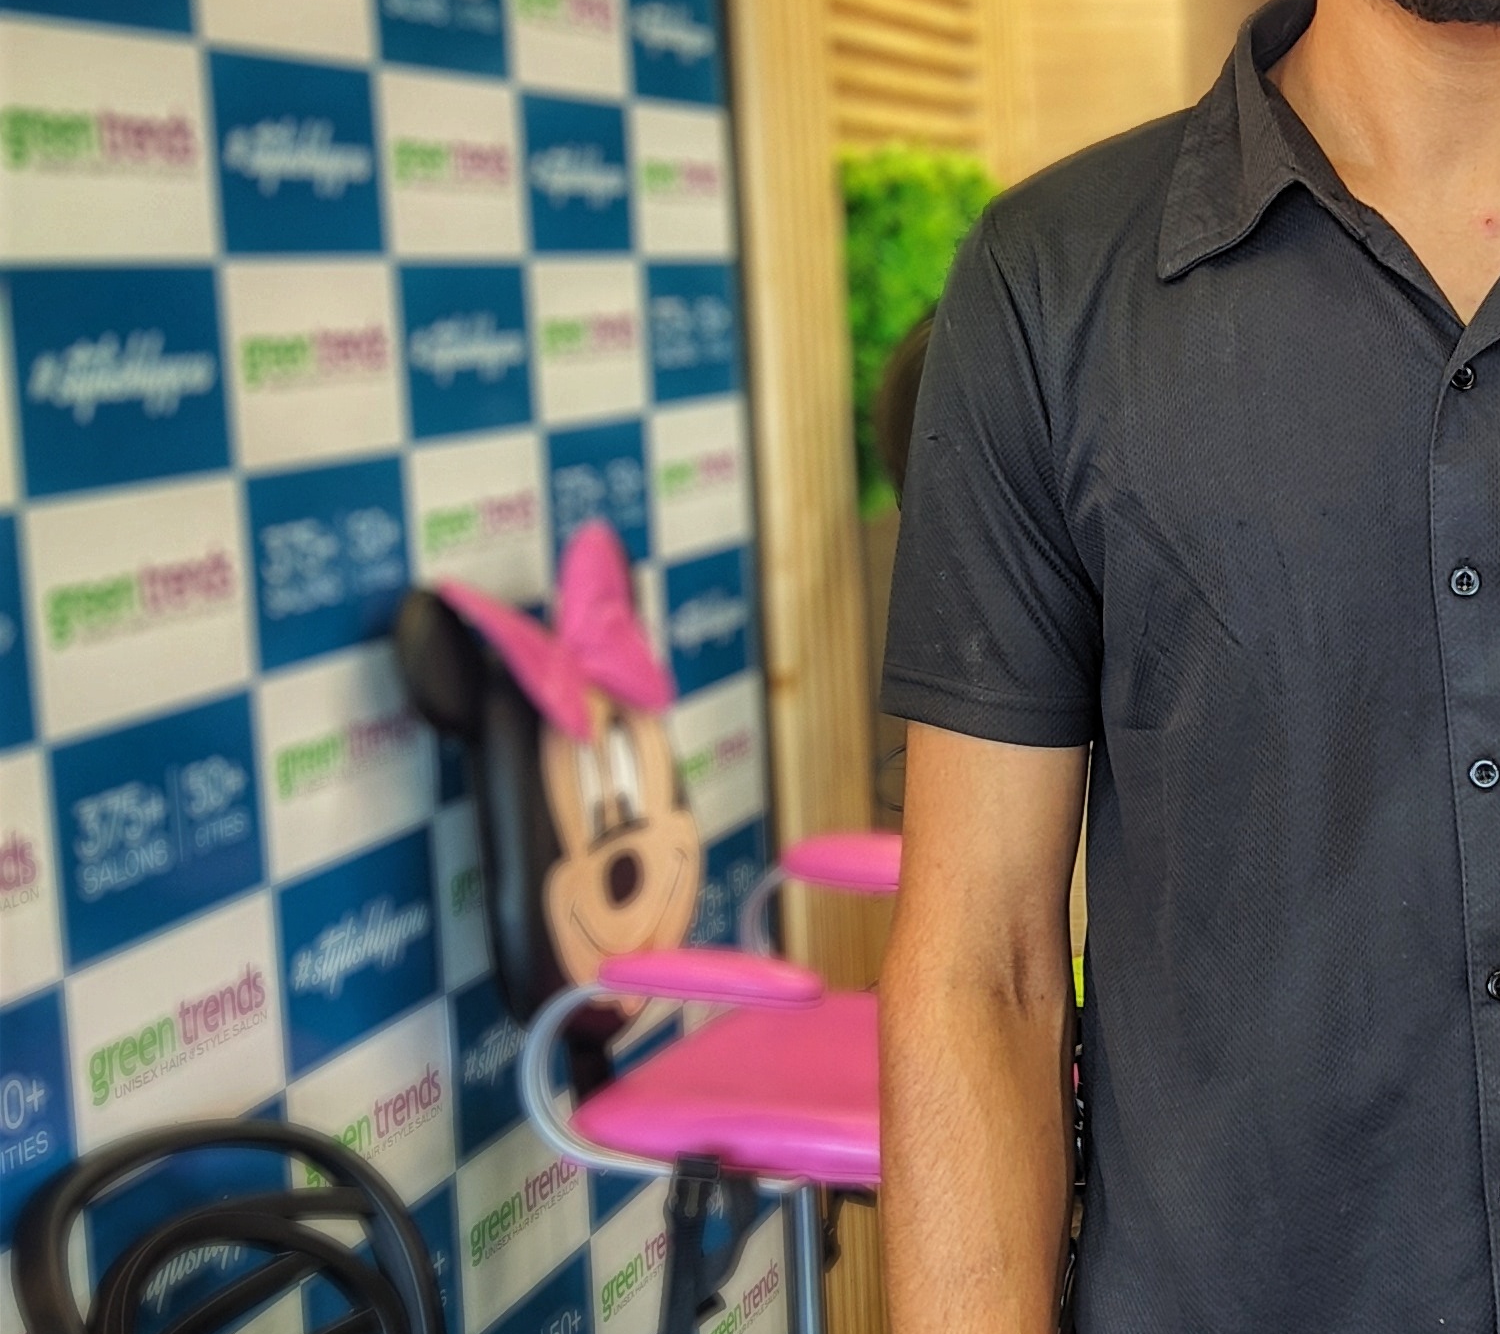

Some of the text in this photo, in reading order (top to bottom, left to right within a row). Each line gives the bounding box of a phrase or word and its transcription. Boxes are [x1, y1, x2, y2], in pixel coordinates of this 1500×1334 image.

[79, 784, 164, 858] 375+
[195, 813, 245, 847] CITIES
[83, 838, 169, 895] SALONS
[0, 886, 40, 913] ALON
[89, 962, 266, 1107] green trends
[114, 1068, 159, 1099] UNISEX
[160, 1052, 188, 1076] HAIR
[196, 1028, 230, 1057] STYLE
[232, 1009, 268, 1037] SALON
[3, 1079, 45, 1130] 0+
[373, 1062, 442, 1139] trends
[388, 1123, 414, 1148] STYLE
[415, 1105, 443, 1130] SALON
[1, 1130, 48, 1175] ITIES
[470, 1191, 523, 1267] green
[602, 1231, 667, 1323] green tre
[742, 1258, 779, 1318] trends
